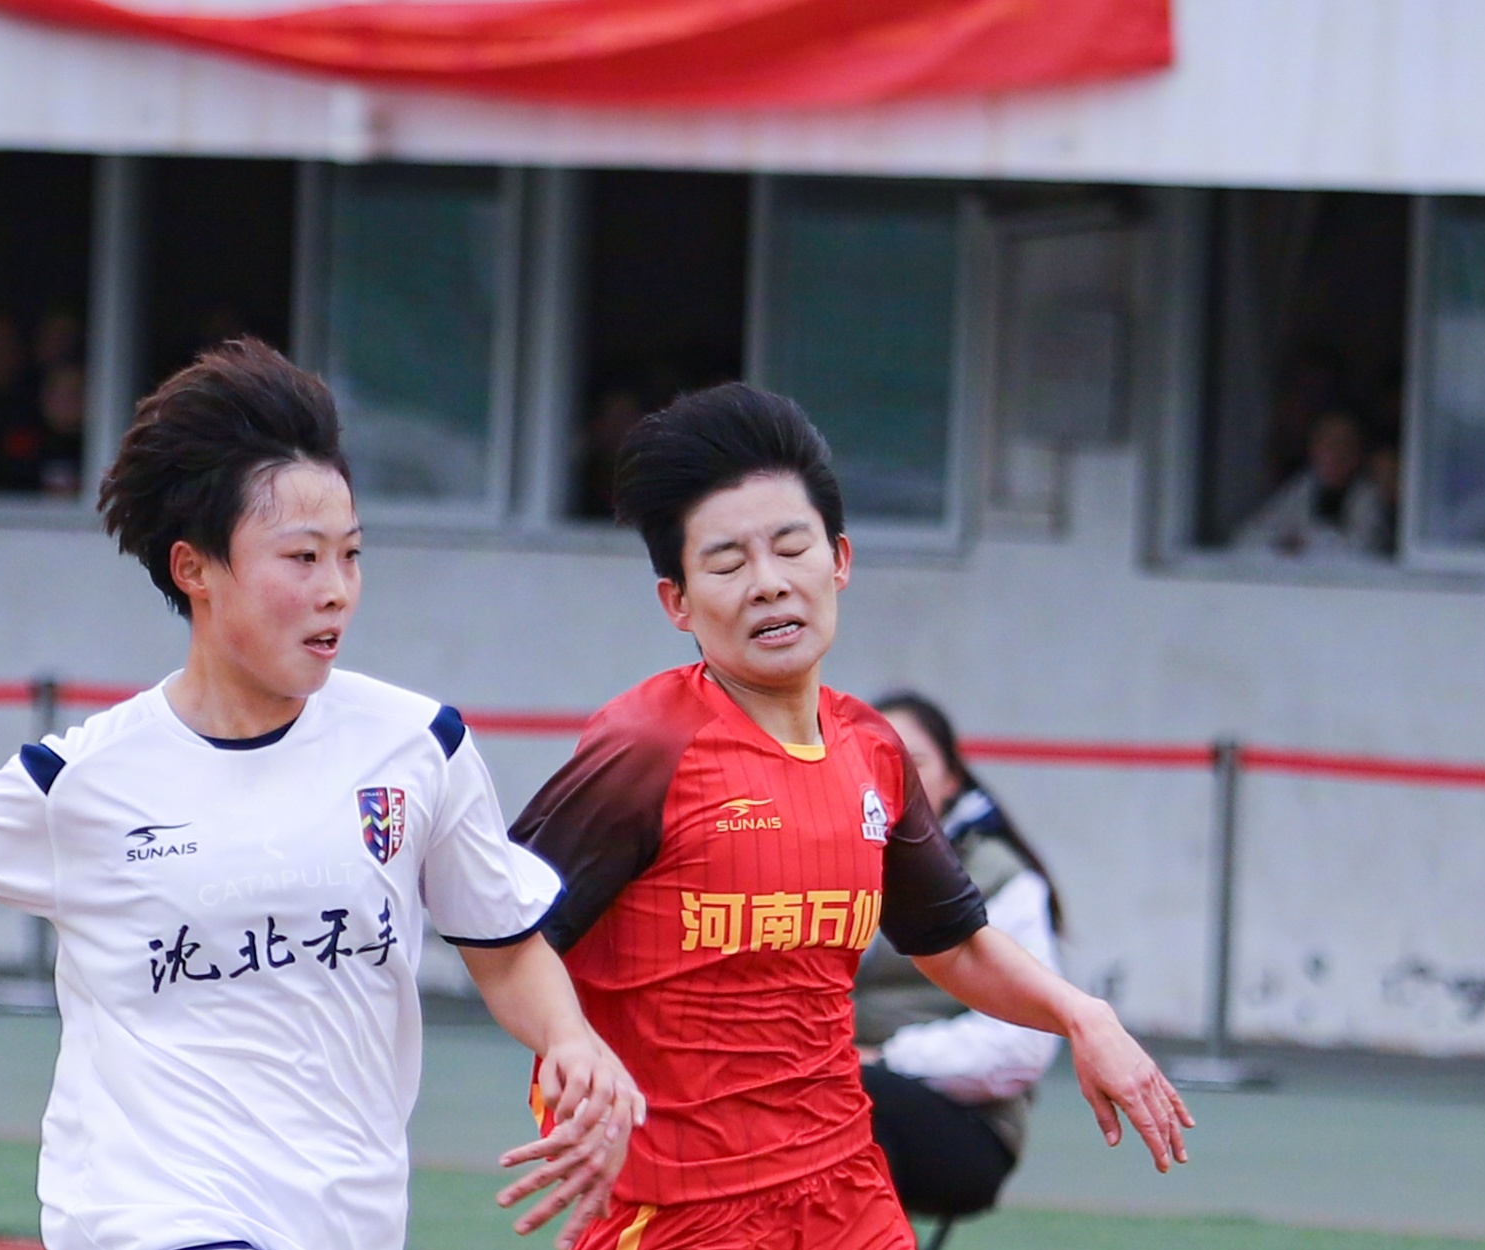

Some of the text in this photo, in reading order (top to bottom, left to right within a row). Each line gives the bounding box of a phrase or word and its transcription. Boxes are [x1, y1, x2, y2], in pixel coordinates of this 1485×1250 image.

[715, 816, 783, 832] SUNAIS
[125, 842, 198, 862] SUNAIS
[197, 862, 354, 906] CATAPULT
